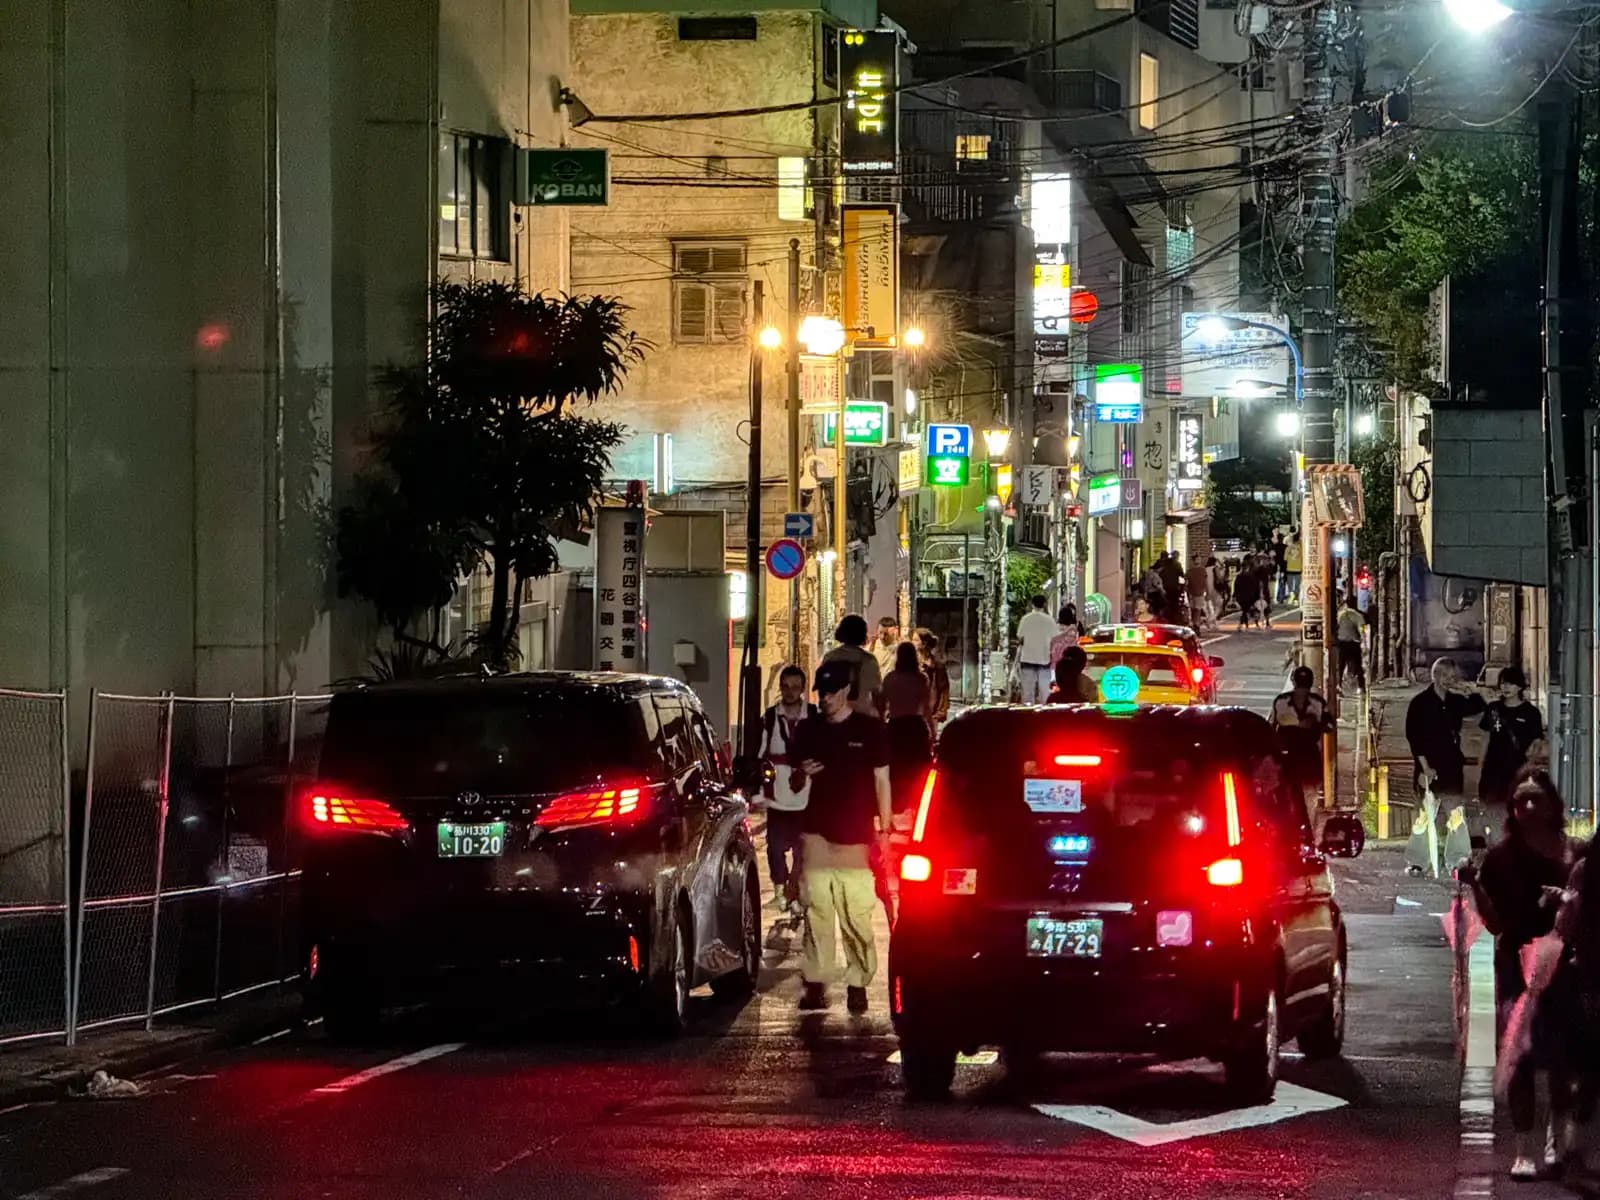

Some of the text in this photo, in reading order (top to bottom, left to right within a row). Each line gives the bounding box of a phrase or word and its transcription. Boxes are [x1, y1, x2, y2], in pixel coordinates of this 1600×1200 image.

[532, 183, 603, 200] KOBAN
[936, 428, 961, 453] P
[621, 521, 638, 660] 警視庁四谷警察署
[454, 835, 501, 856] 10-20
[1042, 934, 1099, 955] 47-29
